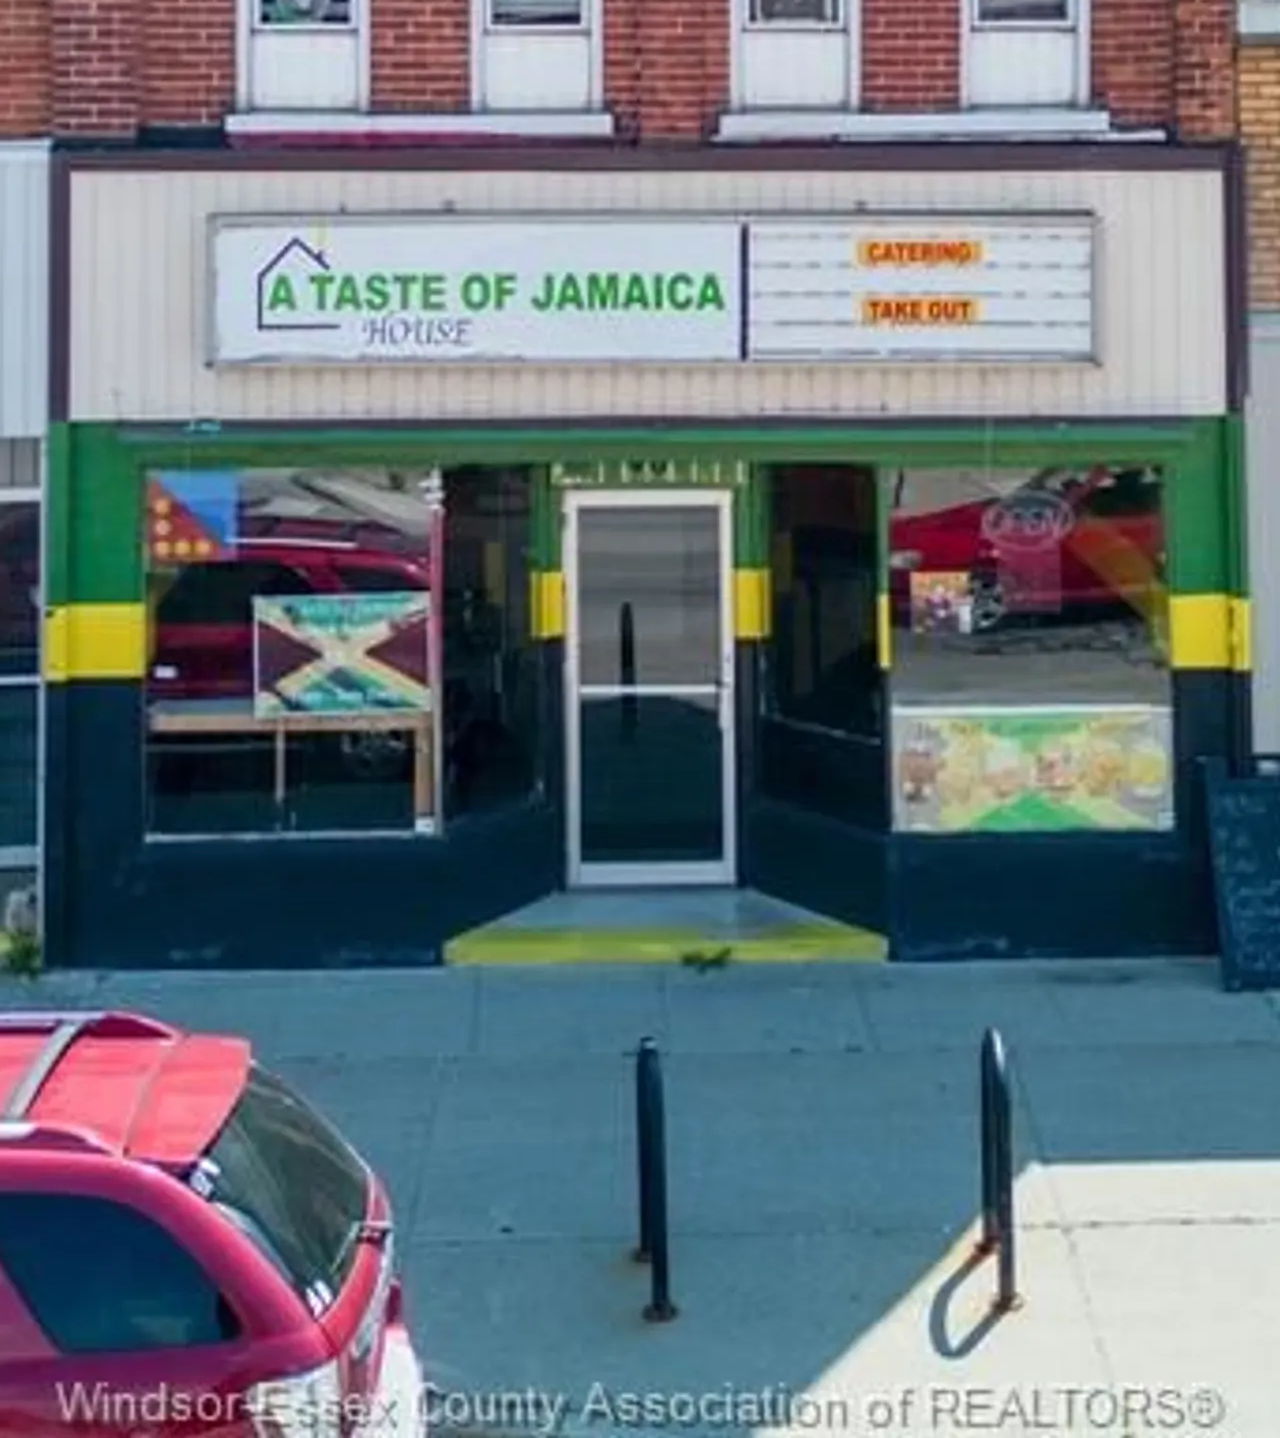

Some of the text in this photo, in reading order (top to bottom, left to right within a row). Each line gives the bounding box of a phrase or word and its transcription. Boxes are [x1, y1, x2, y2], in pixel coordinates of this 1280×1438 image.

[867, 241, 972, 262] CATERING
[267, 275, 727, 310] A TASTE OF JAMAICA
[869, 301, 972, 322] TAKE OUT
[361, 318, 475, 347] HOUSE
